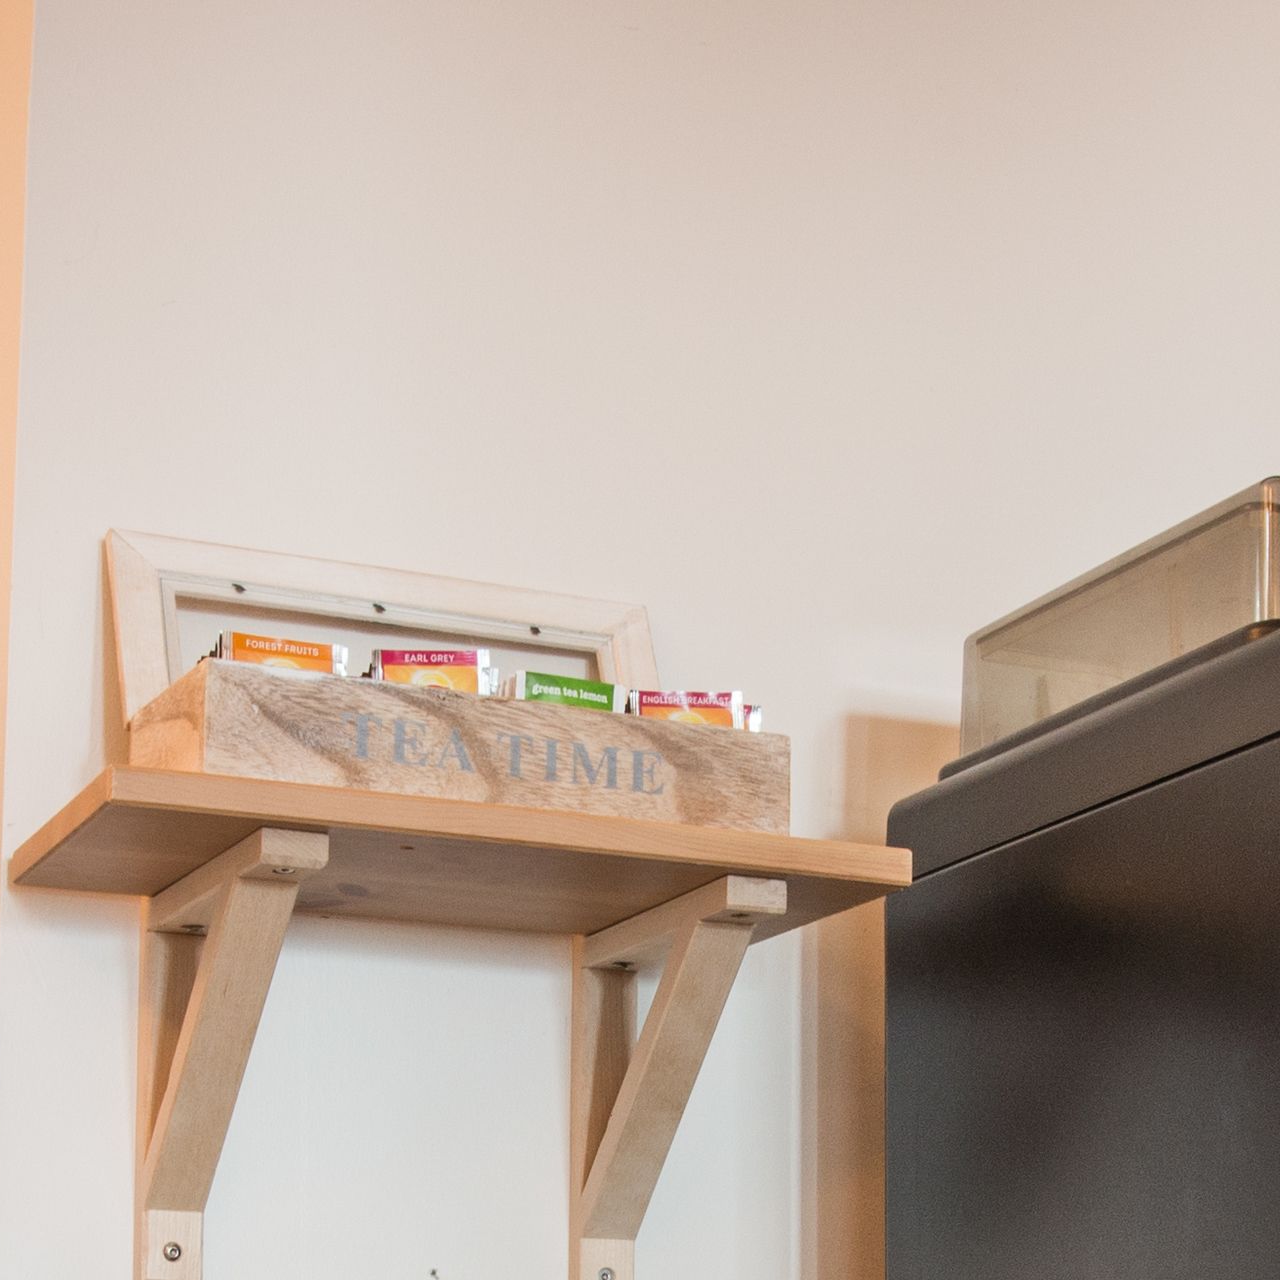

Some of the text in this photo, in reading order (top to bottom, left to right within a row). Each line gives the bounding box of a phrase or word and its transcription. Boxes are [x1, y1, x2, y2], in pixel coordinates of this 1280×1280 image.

[245, 638, 319, 657] FOREST FRUITS
[404, 653, 455, 664] EARL GREY
[532, 683, 608, 704] green tea lemon
[642, 695, 680, 705] ENGLISH
[339, 712, 665, 795] TEA TIME
